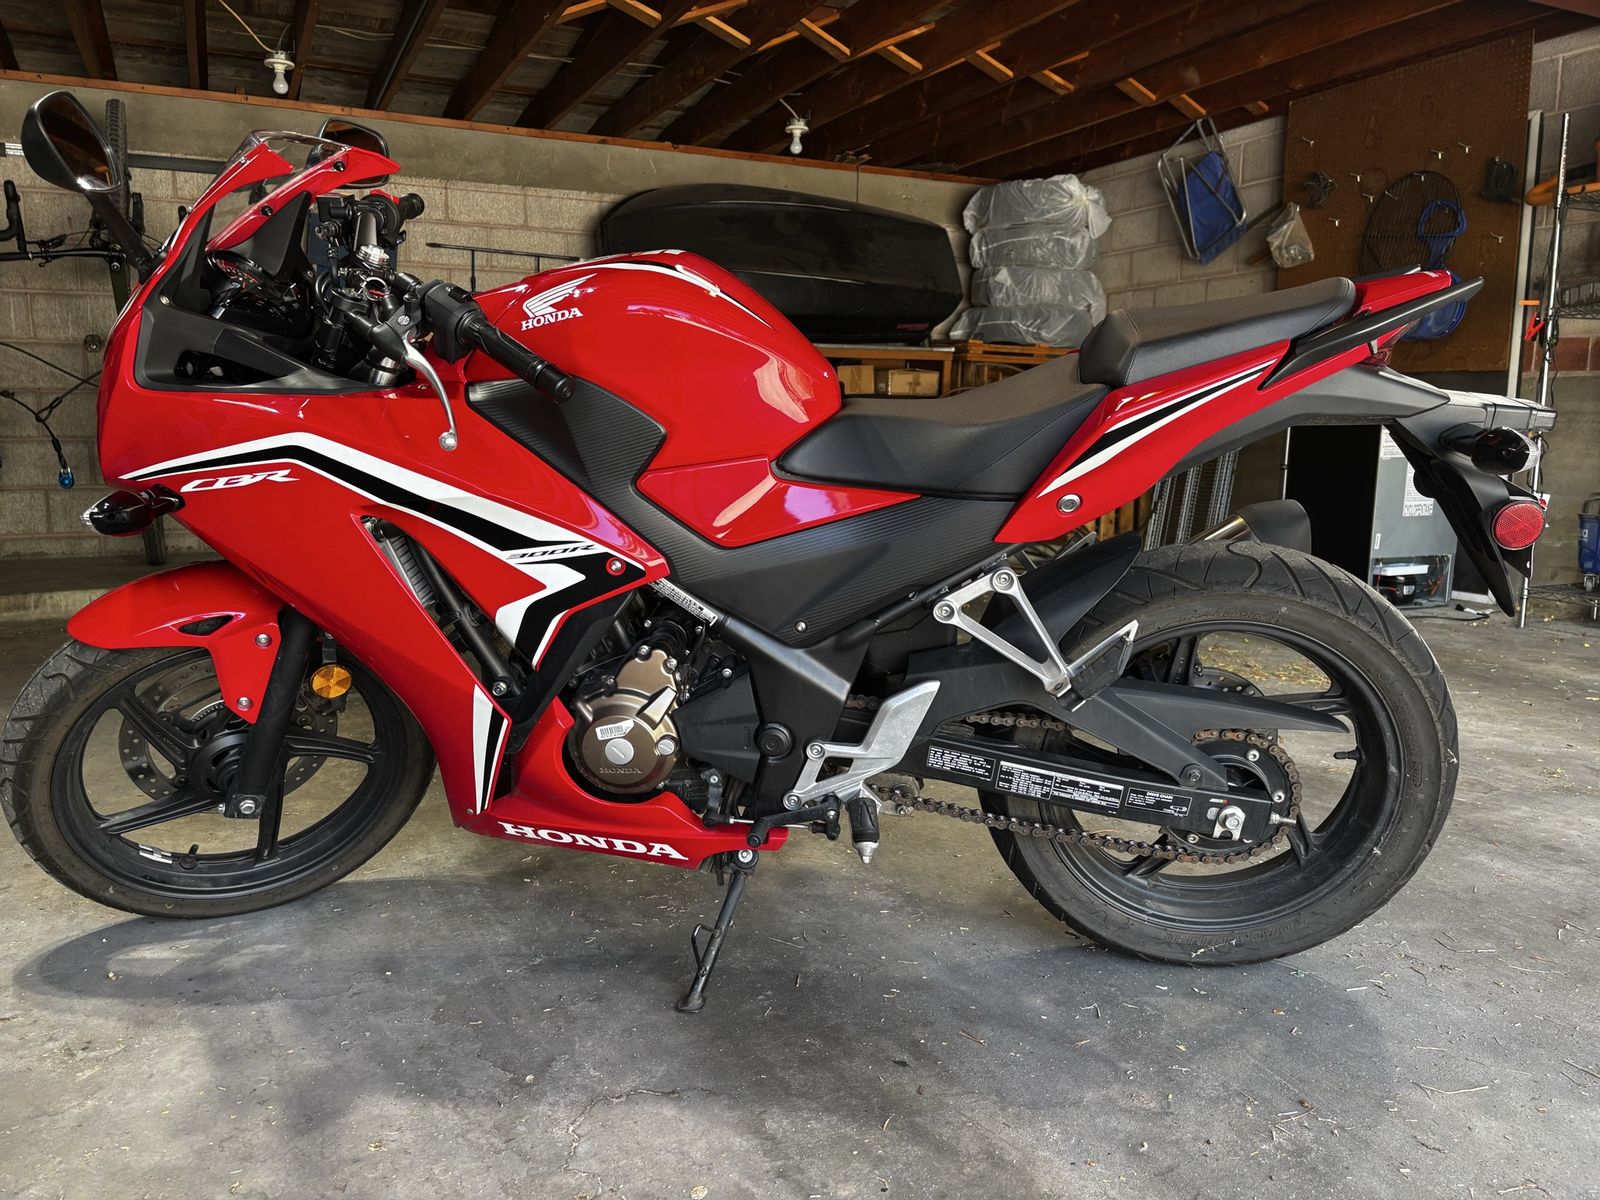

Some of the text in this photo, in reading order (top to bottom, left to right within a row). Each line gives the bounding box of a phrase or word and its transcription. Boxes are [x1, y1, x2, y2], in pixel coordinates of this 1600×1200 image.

[521, 307, 584, 331] HONDA
[180, 469, 301, 493] CBR
[506, 544, 597, 560] 300R
[599, 767, 643, 775] HONDA
[497, 821, 689, 861] HONDA
